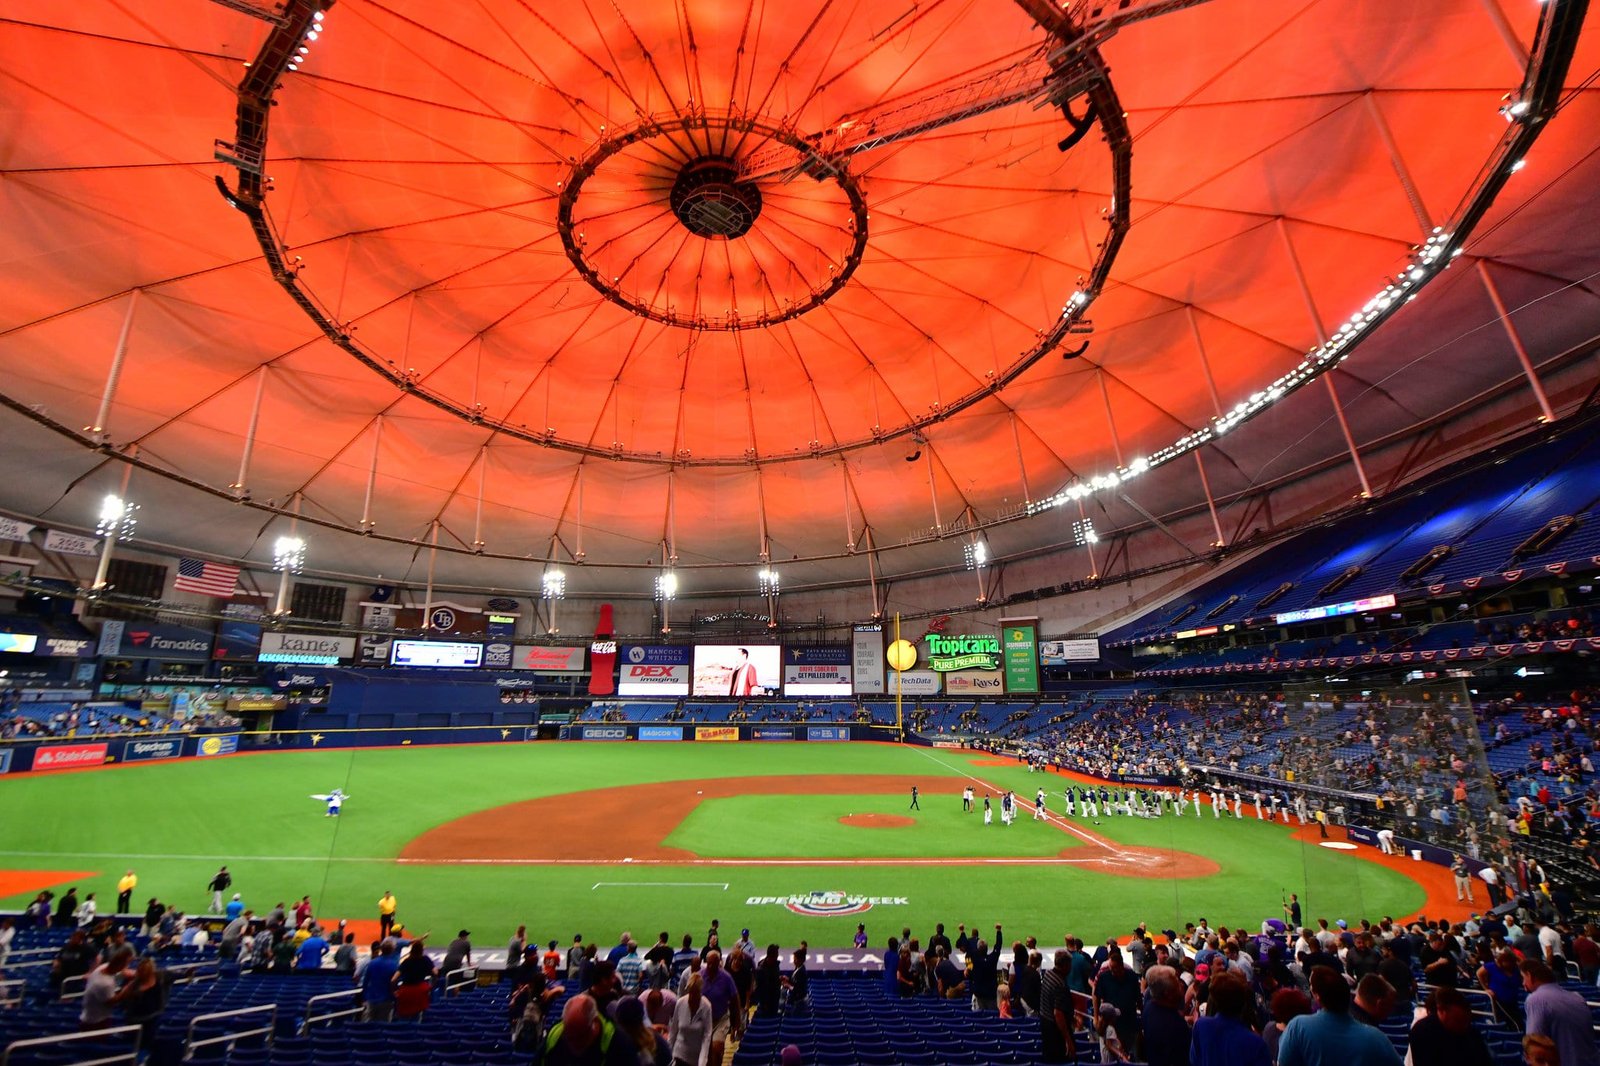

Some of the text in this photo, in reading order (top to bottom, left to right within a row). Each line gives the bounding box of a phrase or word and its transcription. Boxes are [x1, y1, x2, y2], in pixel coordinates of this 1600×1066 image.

[58, 537, 87, 549] 2008
[436, 612, 452, 627] TB
[150, 636, 209, 651] Fanatics
[278, 635, 341, 652] kanes
[925, 634, 999, 656] Tropicana
[486, 653, 511, 661] ROSE
[934, 656, 990, 669] PURE PREMIUM
[630, 666, 676, 677] DEX
[993, 678, 1000, 687] 6
[584, 729, 625, 738] GEICO
[134, 742, 173, 754] Spectrum
[745, 895, 909, 905] OPENING WEEK
